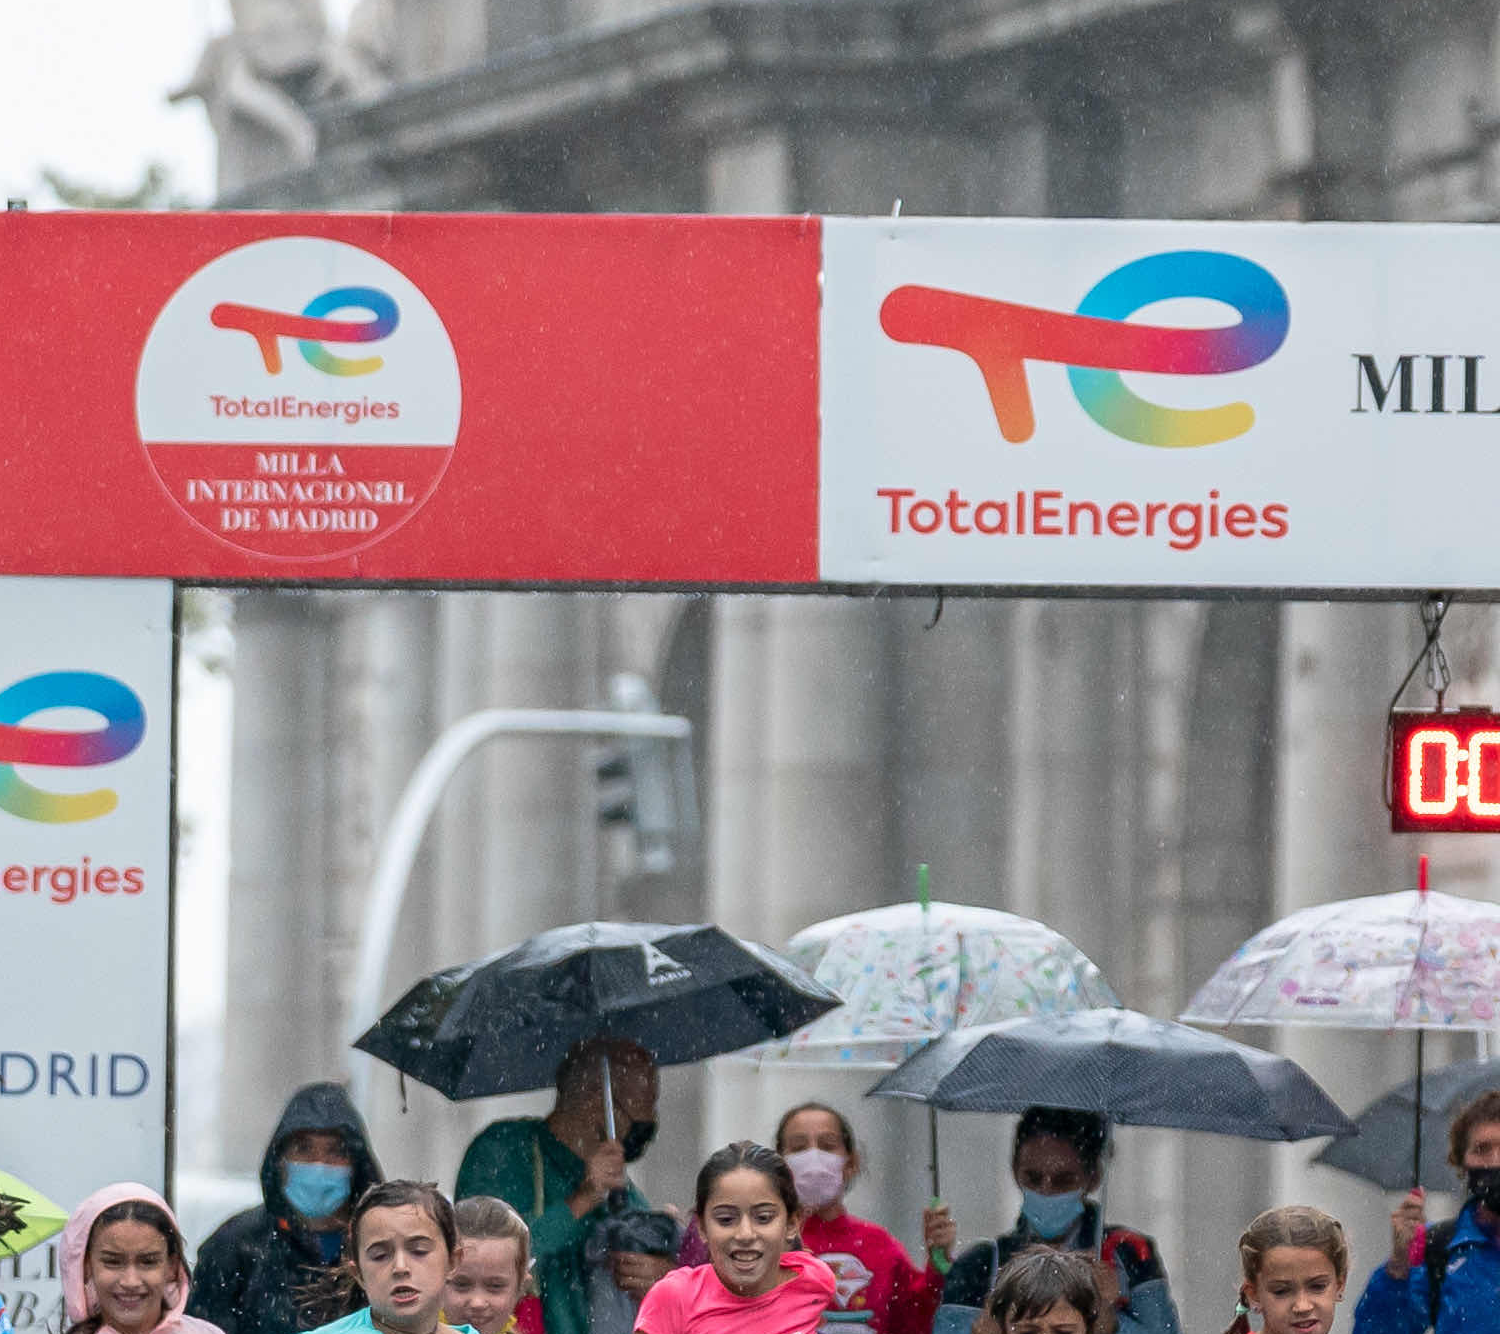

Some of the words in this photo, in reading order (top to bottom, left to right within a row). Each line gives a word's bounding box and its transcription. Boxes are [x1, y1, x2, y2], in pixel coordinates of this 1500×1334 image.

[210, 395, 401, 424] TotalEnergies
[255, 451, 346, 476] MILLA
[220, 507, 261, 532] DE
[265, 508, 380, 533] MADRID
[876, 487, 1290, 553] TotalEnergies
